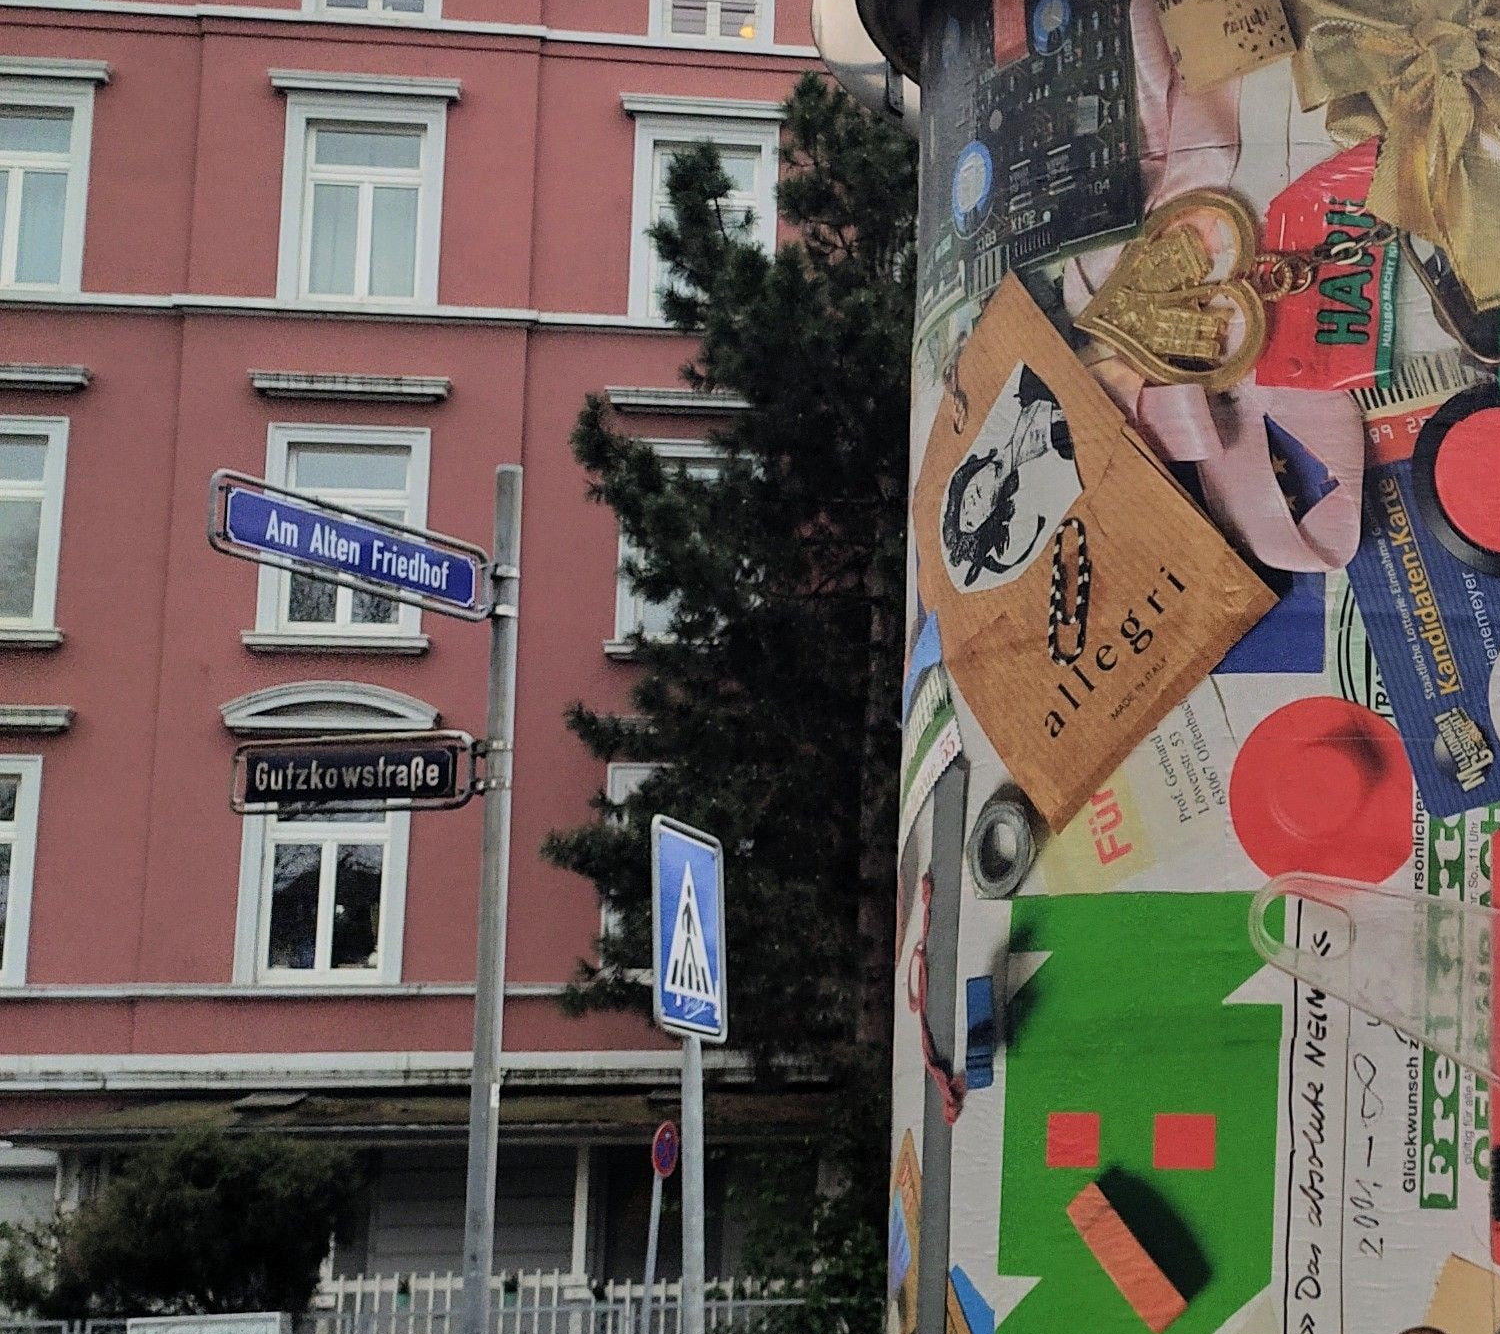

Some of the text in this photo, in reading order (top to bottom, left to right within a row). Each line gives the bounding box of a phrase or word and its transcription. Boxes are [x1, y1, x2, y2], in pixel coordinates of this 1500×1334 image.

[1382, 297, 1396, 348] HARIBO
[265, 510, 450, 592] Am Alten Friedhof
[1377, 476, 1460, 696] Kandidaten-Karte
[1044, 566, 1187, 739] allegri
[254, 755, 441, 793] Gutzkowstraße
[1149, 734, 1193, 824] Prof. Gerhard
[1201, 766, 1228, 807] 63067
[1303, 986, 1329, 1068] NEIN
[1299, 1080, 1328, 1228] absolute
[1402, 1051, 1420, 1194] Glückwunsch
